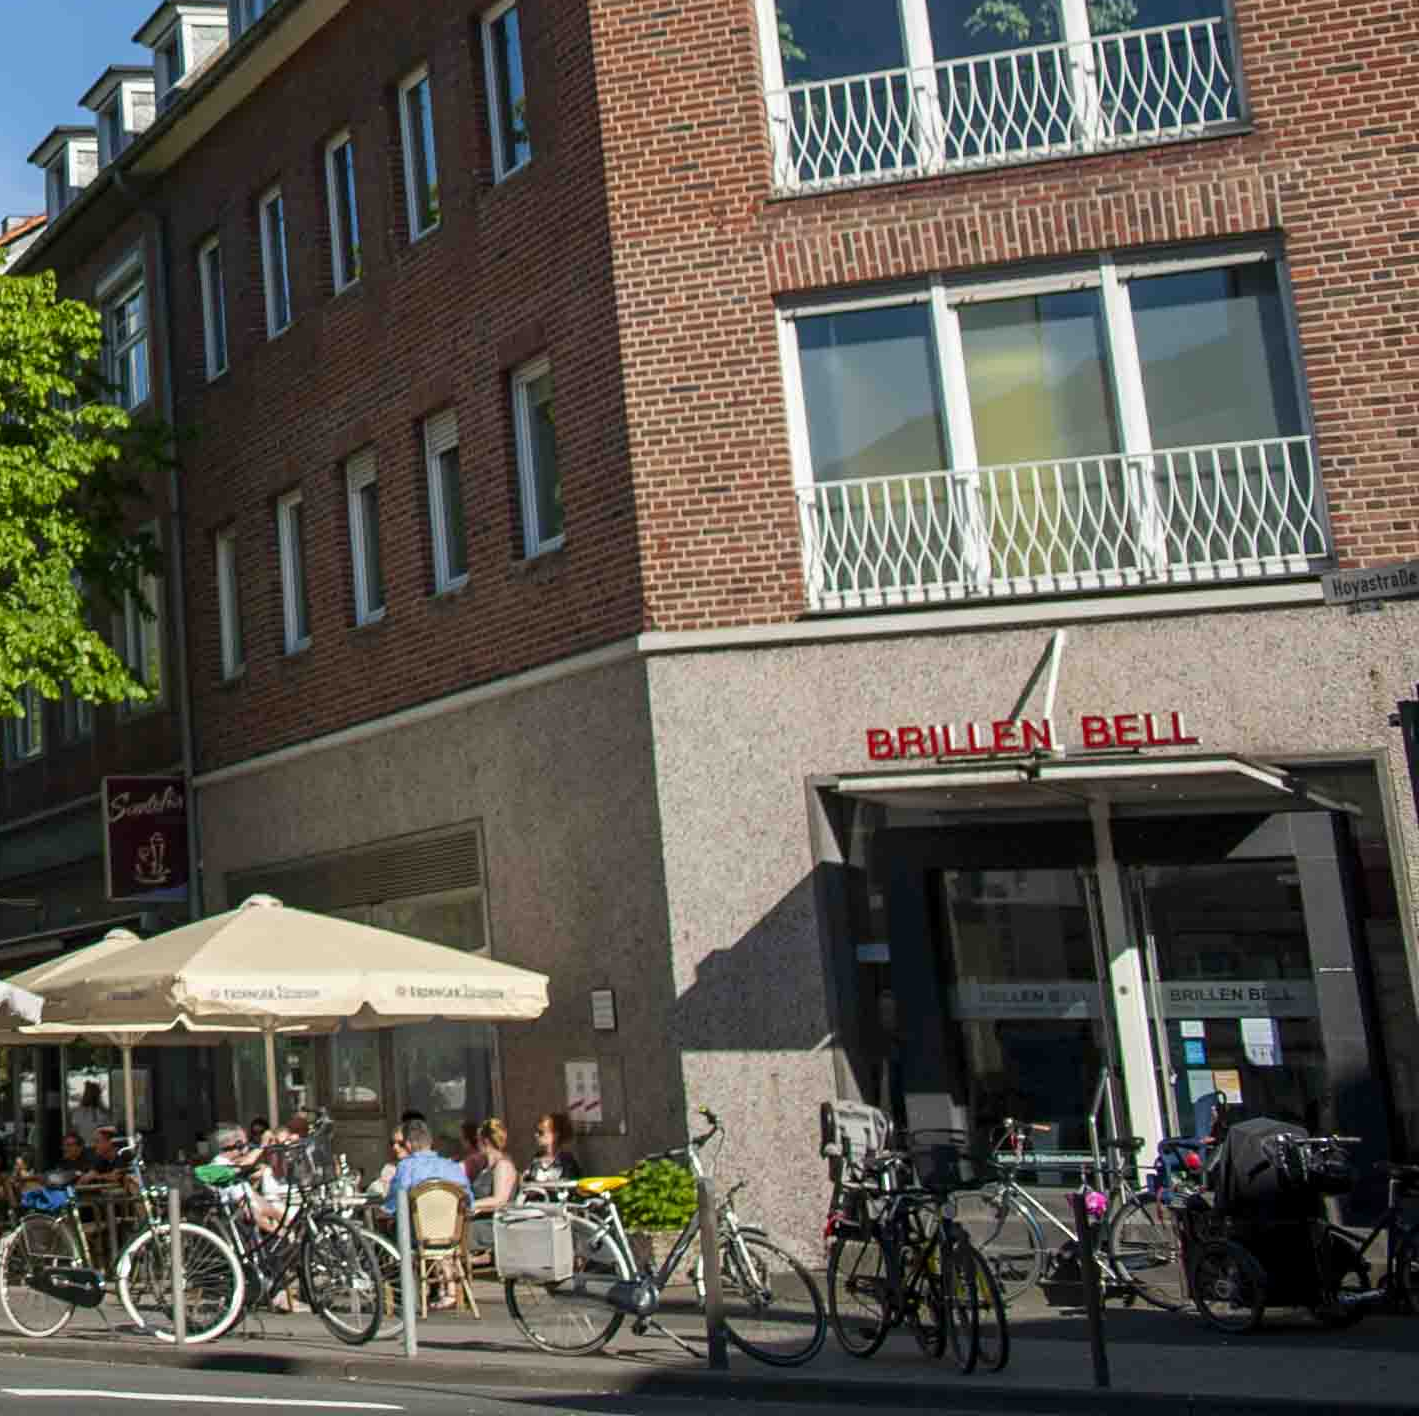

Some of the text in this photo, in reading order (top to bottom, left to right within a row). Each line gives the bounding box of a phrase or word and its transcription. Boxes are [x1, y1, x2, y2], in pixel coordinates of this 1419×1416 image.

[1331, 567, 1418, 600] Hoyastraße
[865, 711, 1201, 761] BRILLEN BELL
[1170, 987, 1243, 1001] BRILLEN
